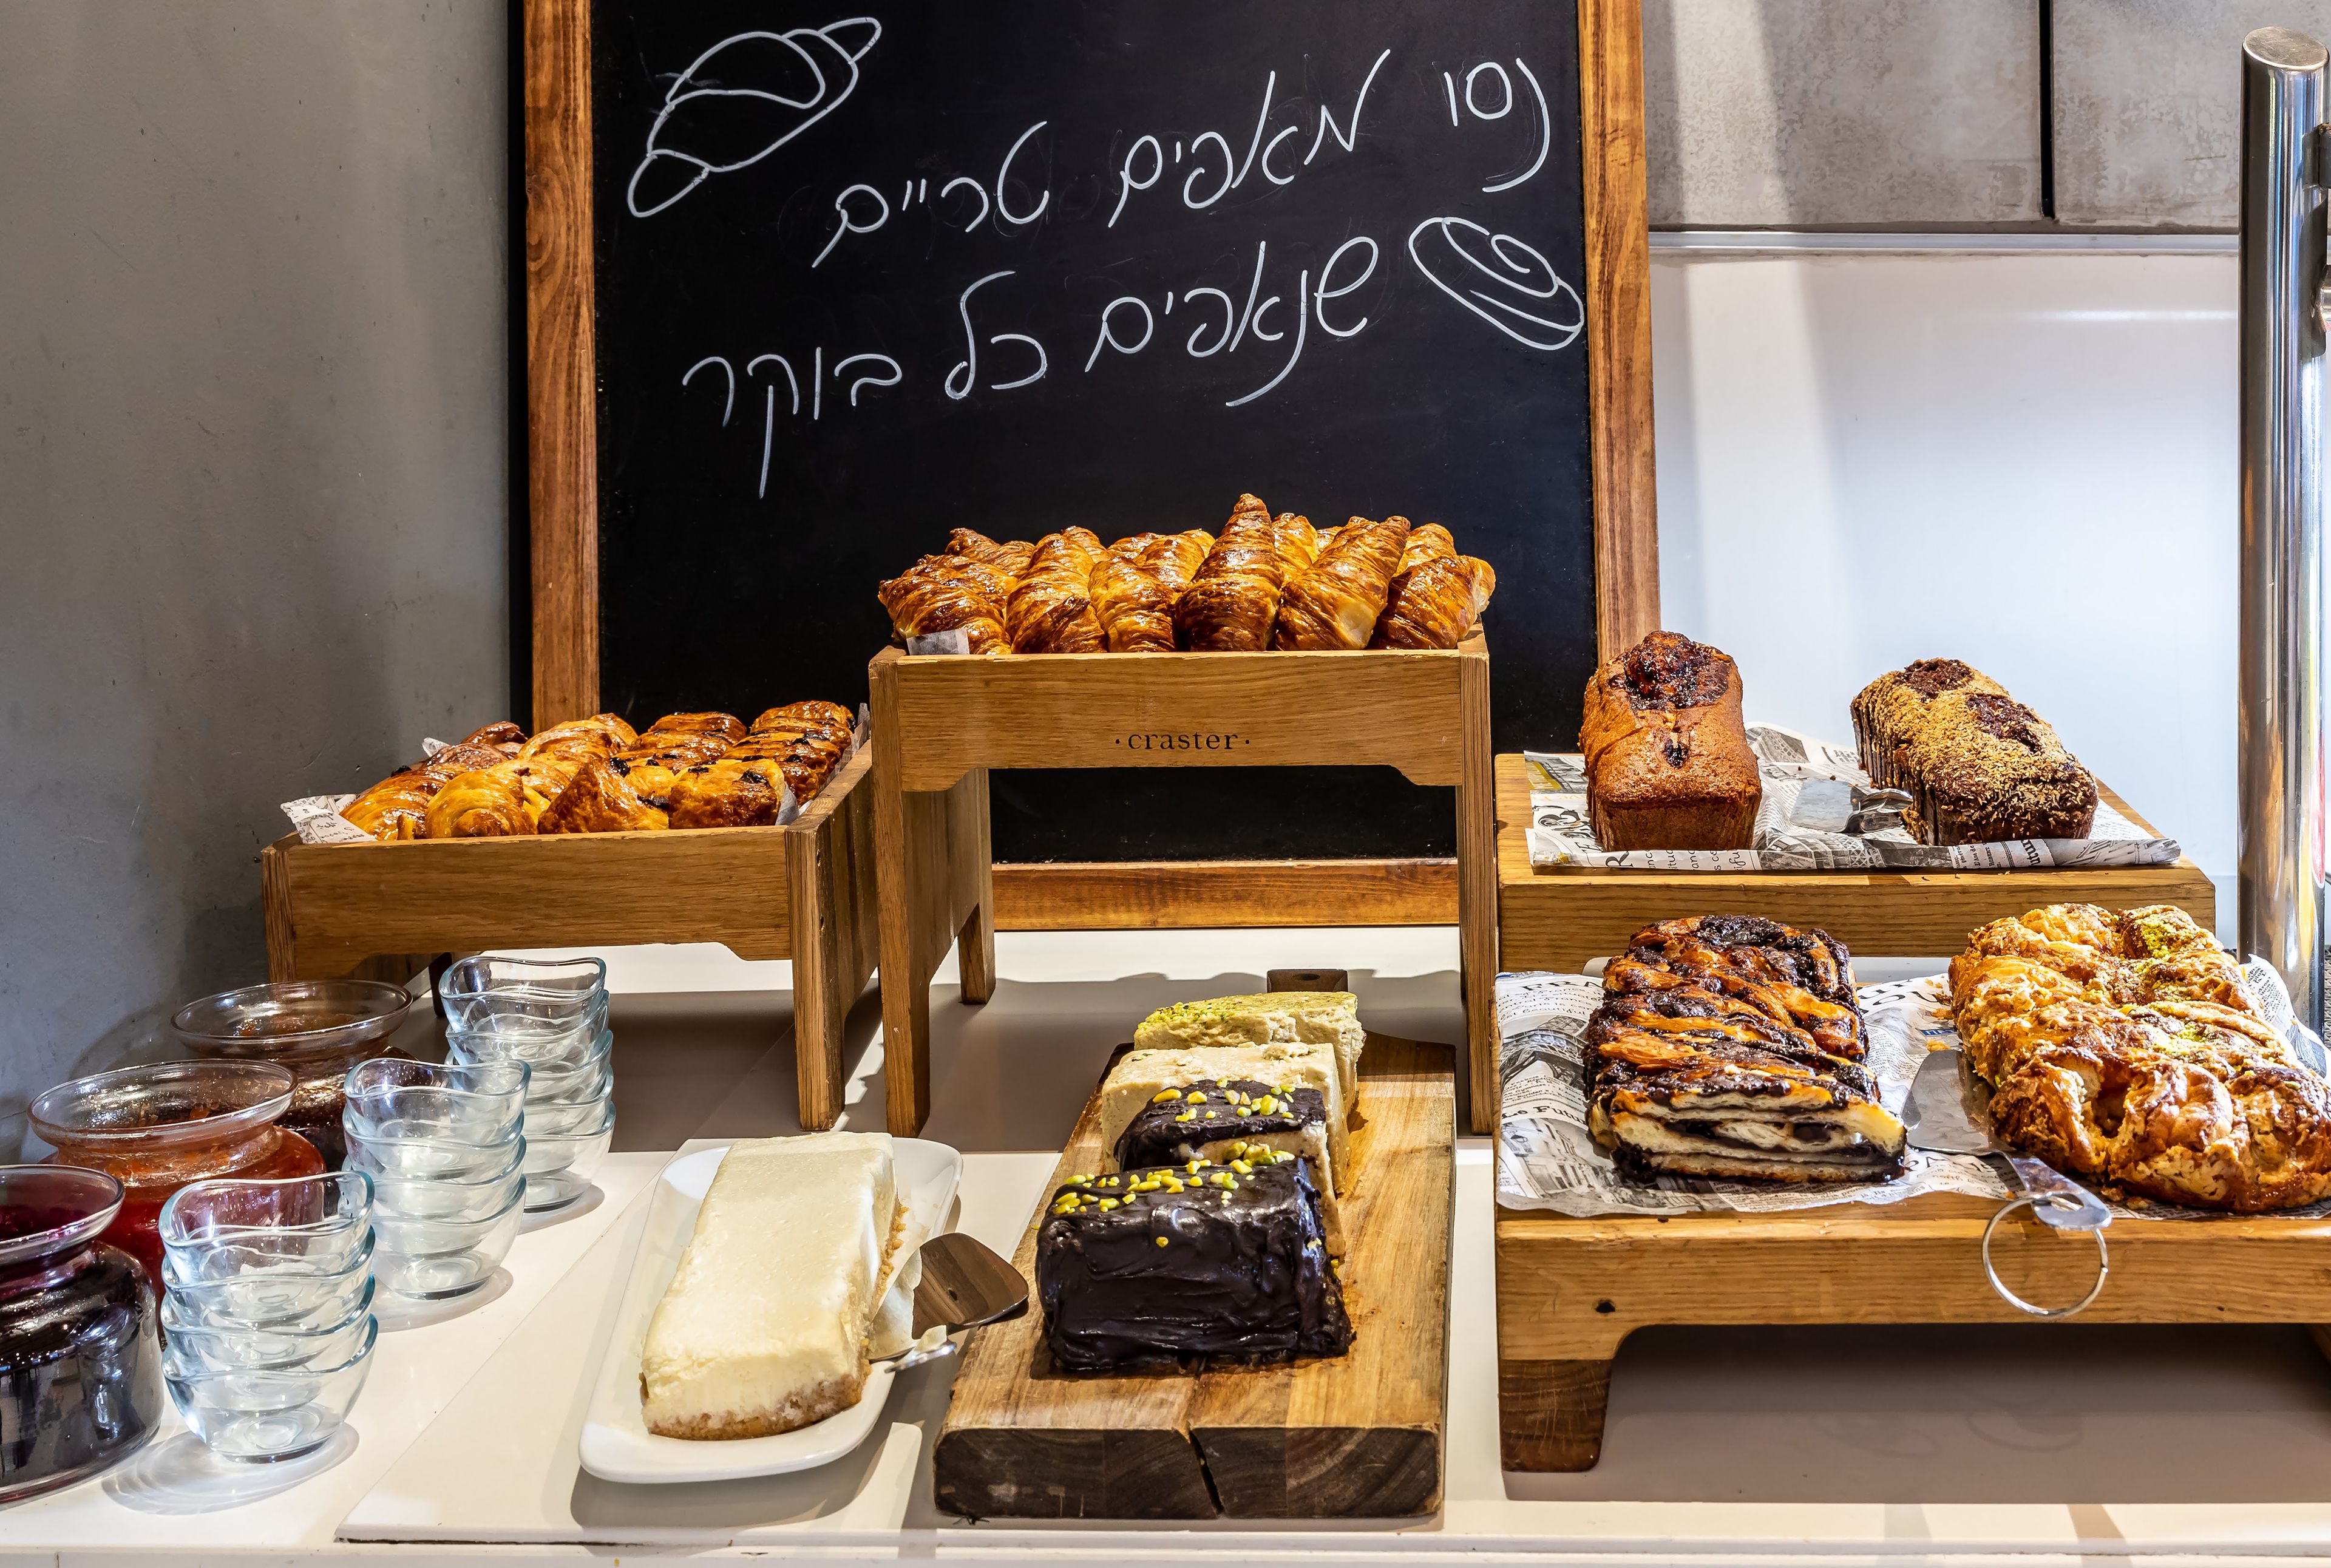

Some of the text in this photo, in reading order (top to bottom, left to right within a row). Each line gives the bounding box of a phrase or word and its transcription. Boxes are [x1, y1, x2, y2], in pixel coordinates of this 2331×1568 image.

[812, 49, 1550, 268] נסו מאפים טריים
[682, 236, 1379, 499] שנאפים כל בוקר
[1127, 731, 1238, 750] craster
